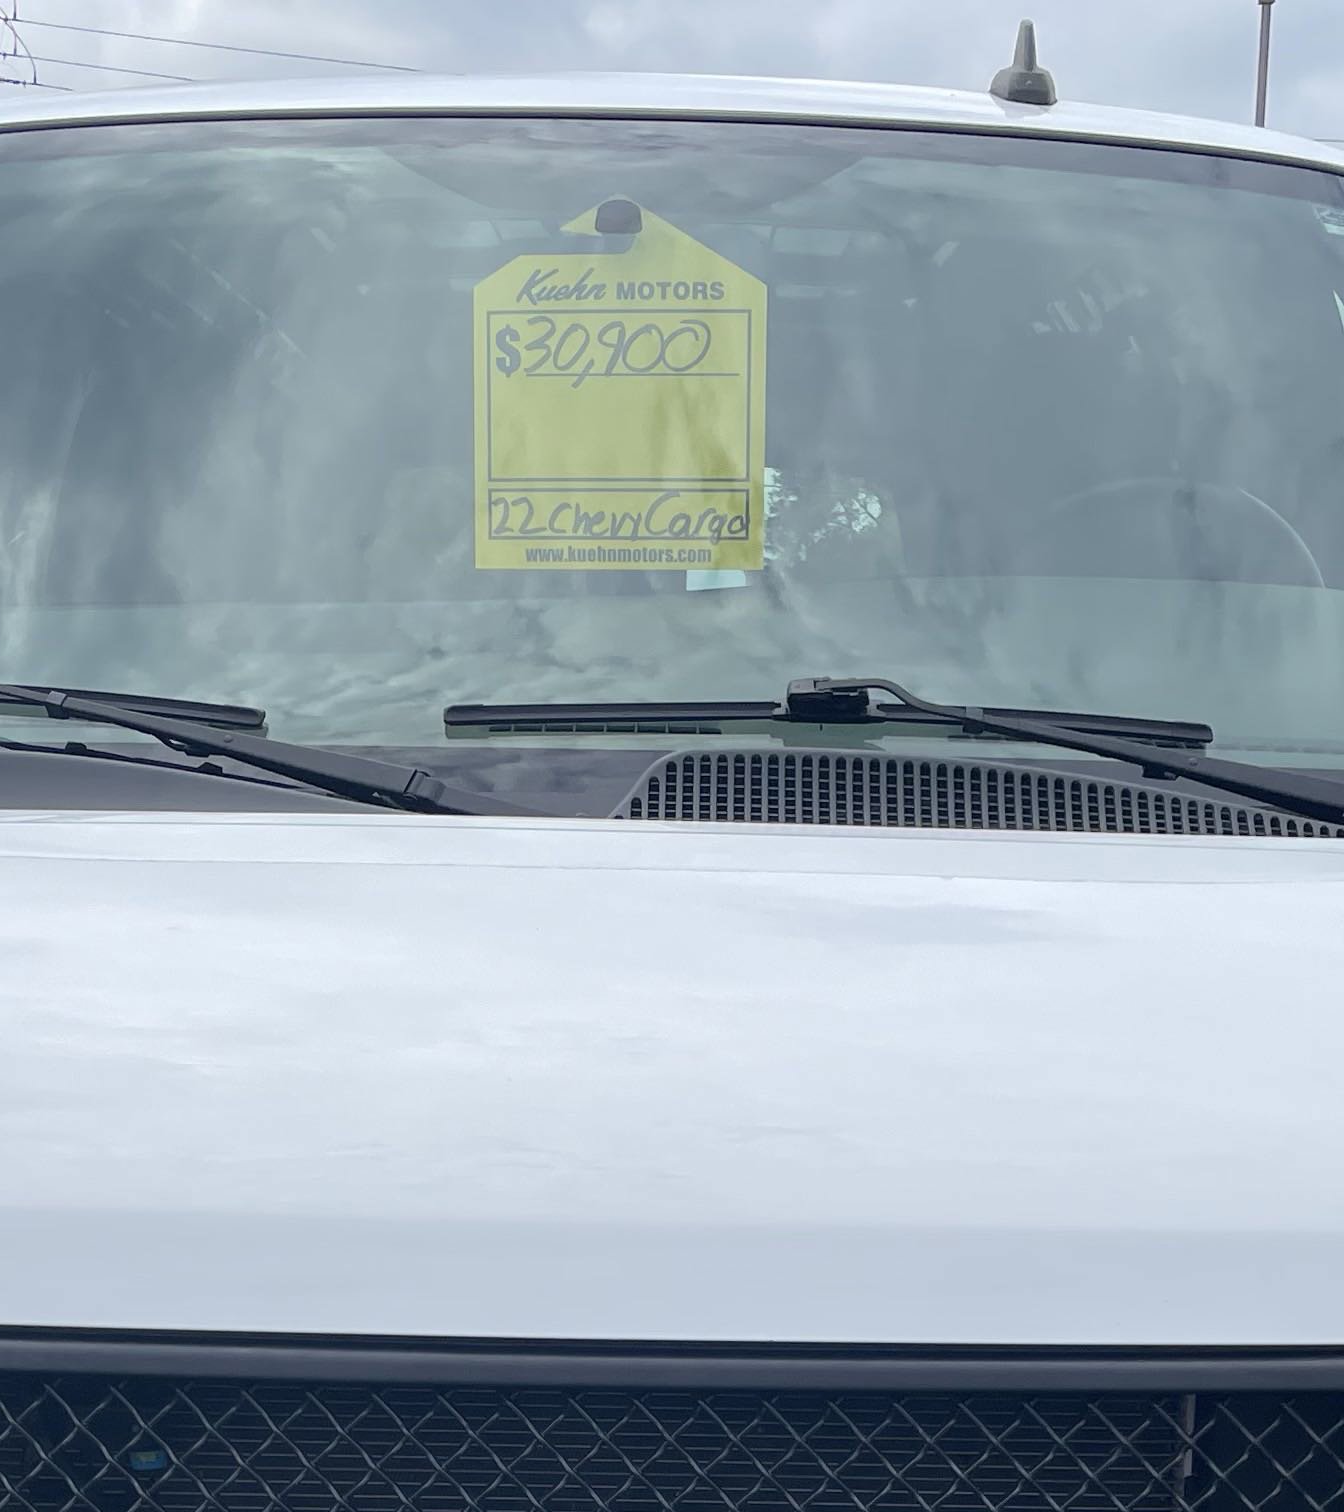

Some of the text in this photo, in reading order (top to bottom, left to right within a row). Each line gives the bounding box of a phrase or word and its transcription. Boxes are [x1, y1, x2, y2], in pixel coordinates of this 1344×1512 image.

[516, 268, 726, 306] Kuehn MOTORS
[525, 545, 712, 564] www.kuehnmotors.com
